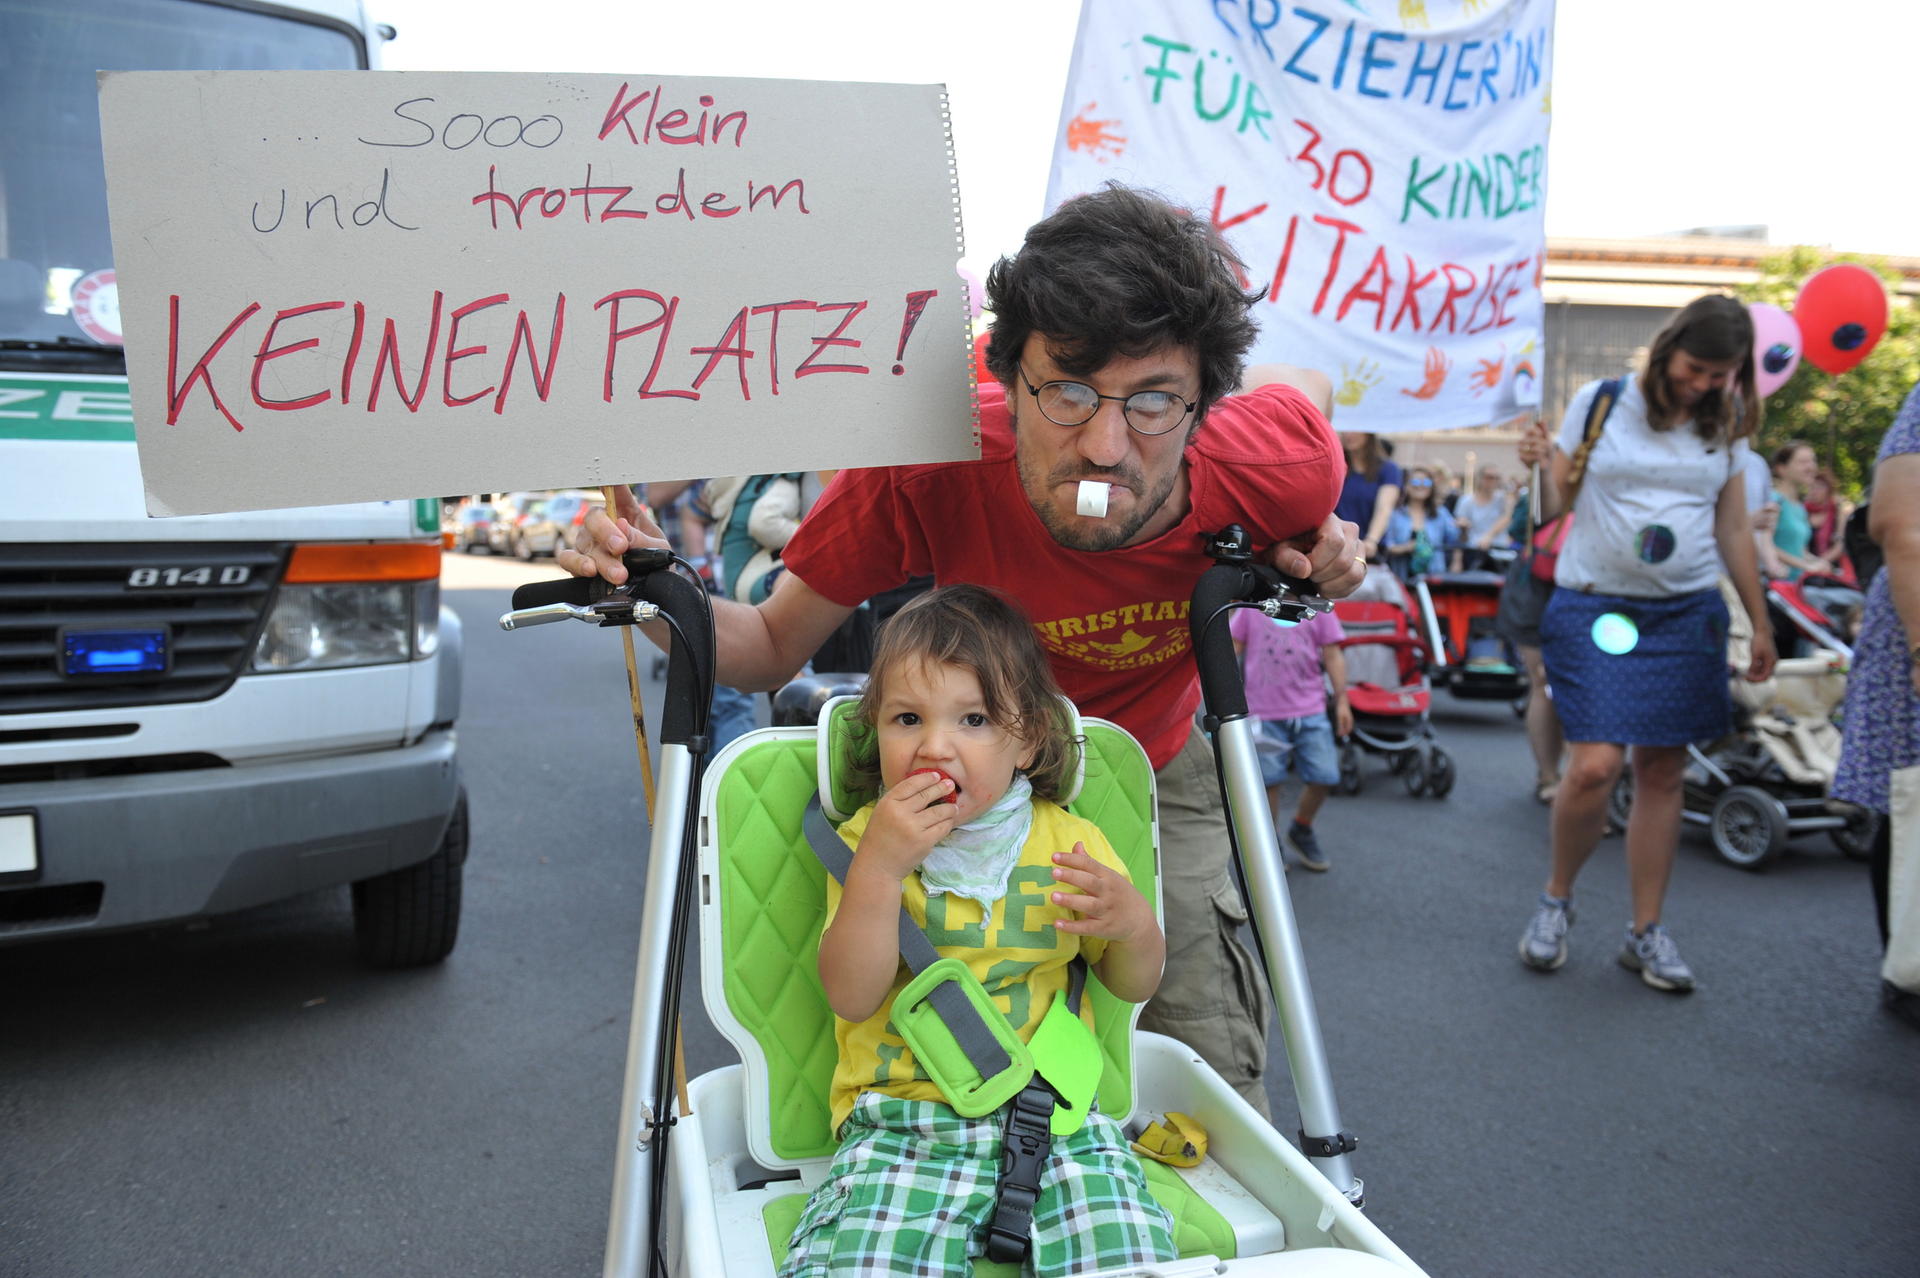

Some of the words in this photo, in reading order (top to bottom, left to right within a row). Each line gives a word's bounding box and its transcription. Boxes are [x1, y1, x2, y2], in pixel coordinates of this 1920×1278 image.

[598, 82, 749, 147] Klein
[1142, 34, 1274, 142] FÜR
[1293, 118, 1374, 206] 30
[1400, 143, 1543, 222] KINDER
[252, 168, 420, 233] und
[472, 163, 810, 230] trotzdem
[166, 290, 566, 432] KEINEN
[128, 567, 211, 587] 814
[220, 565, 250, 585] D
